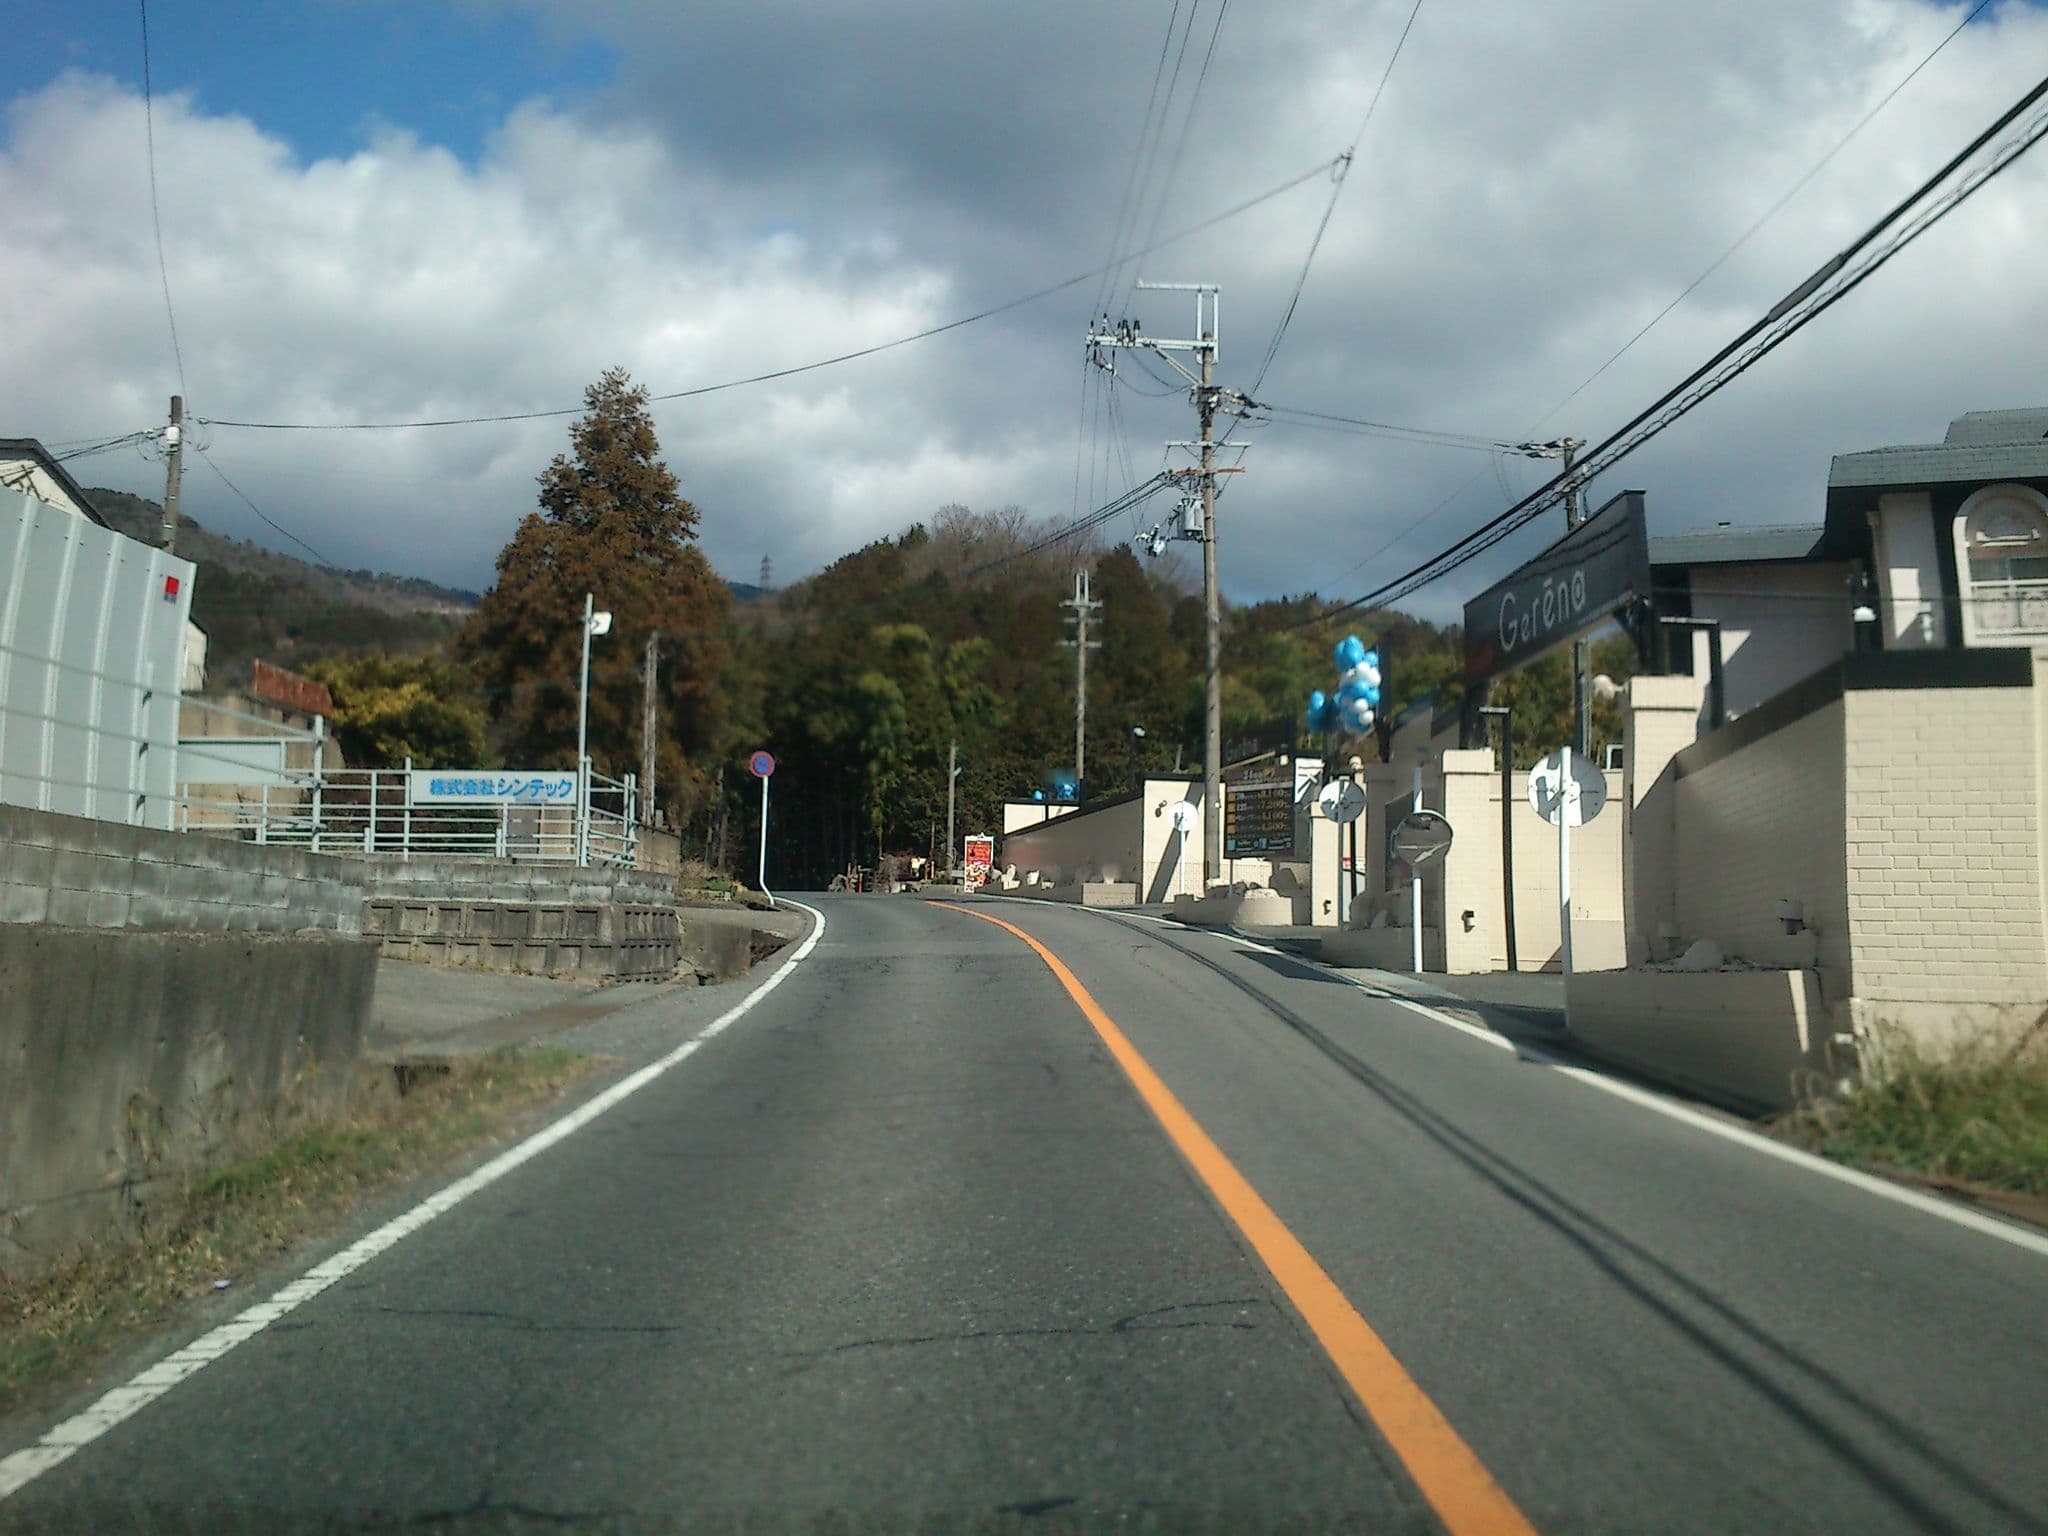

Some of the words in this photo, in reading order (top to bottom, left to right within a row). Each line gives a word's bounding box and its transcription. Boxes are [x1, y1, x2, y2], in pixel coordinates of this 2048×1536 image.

[430, 778, 573, 798] 株式会社シンテック
